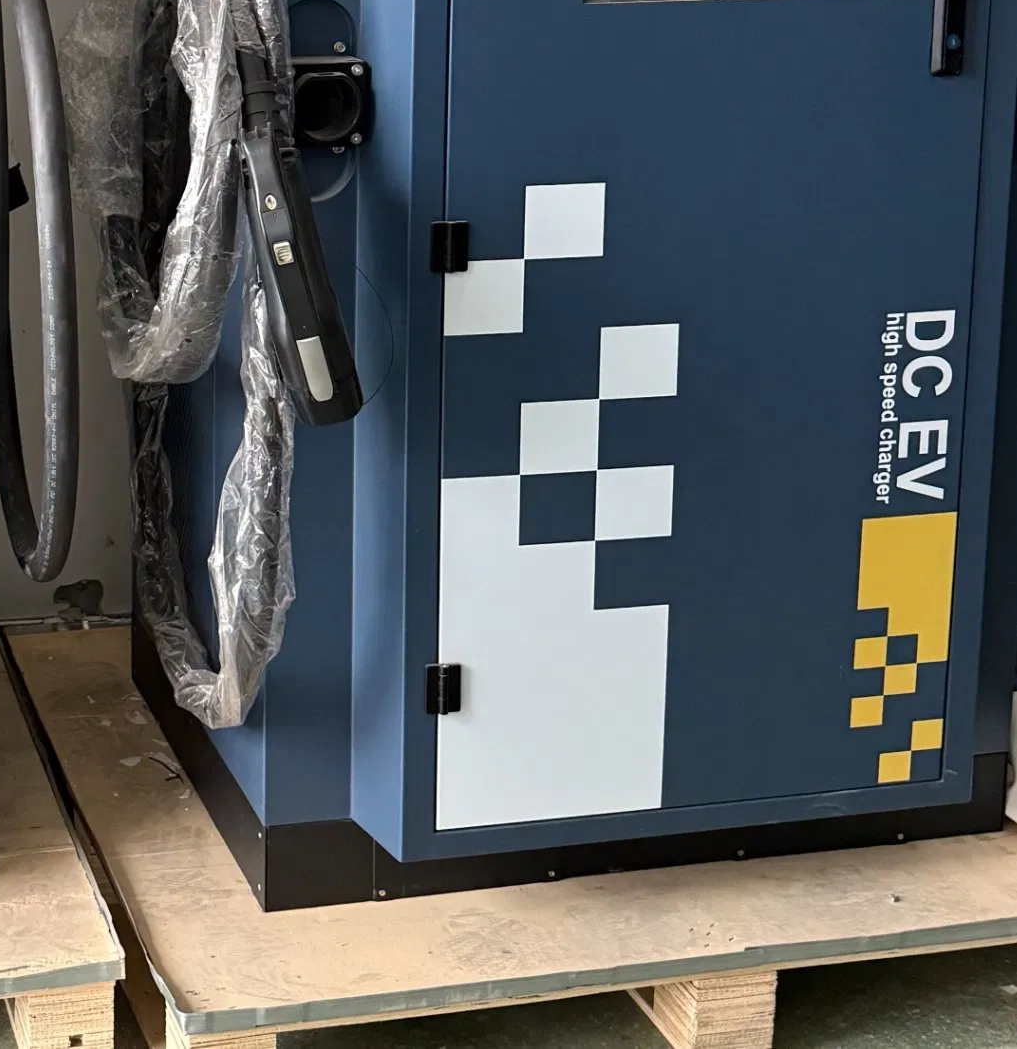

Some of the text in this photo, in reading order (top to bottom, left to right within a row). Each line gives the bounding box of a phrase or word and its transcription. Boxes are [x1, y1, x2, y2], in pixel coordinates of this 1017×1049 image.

[872, 312, 905, 505] high speed charger
[896, 309, 956, 500] DC EV
